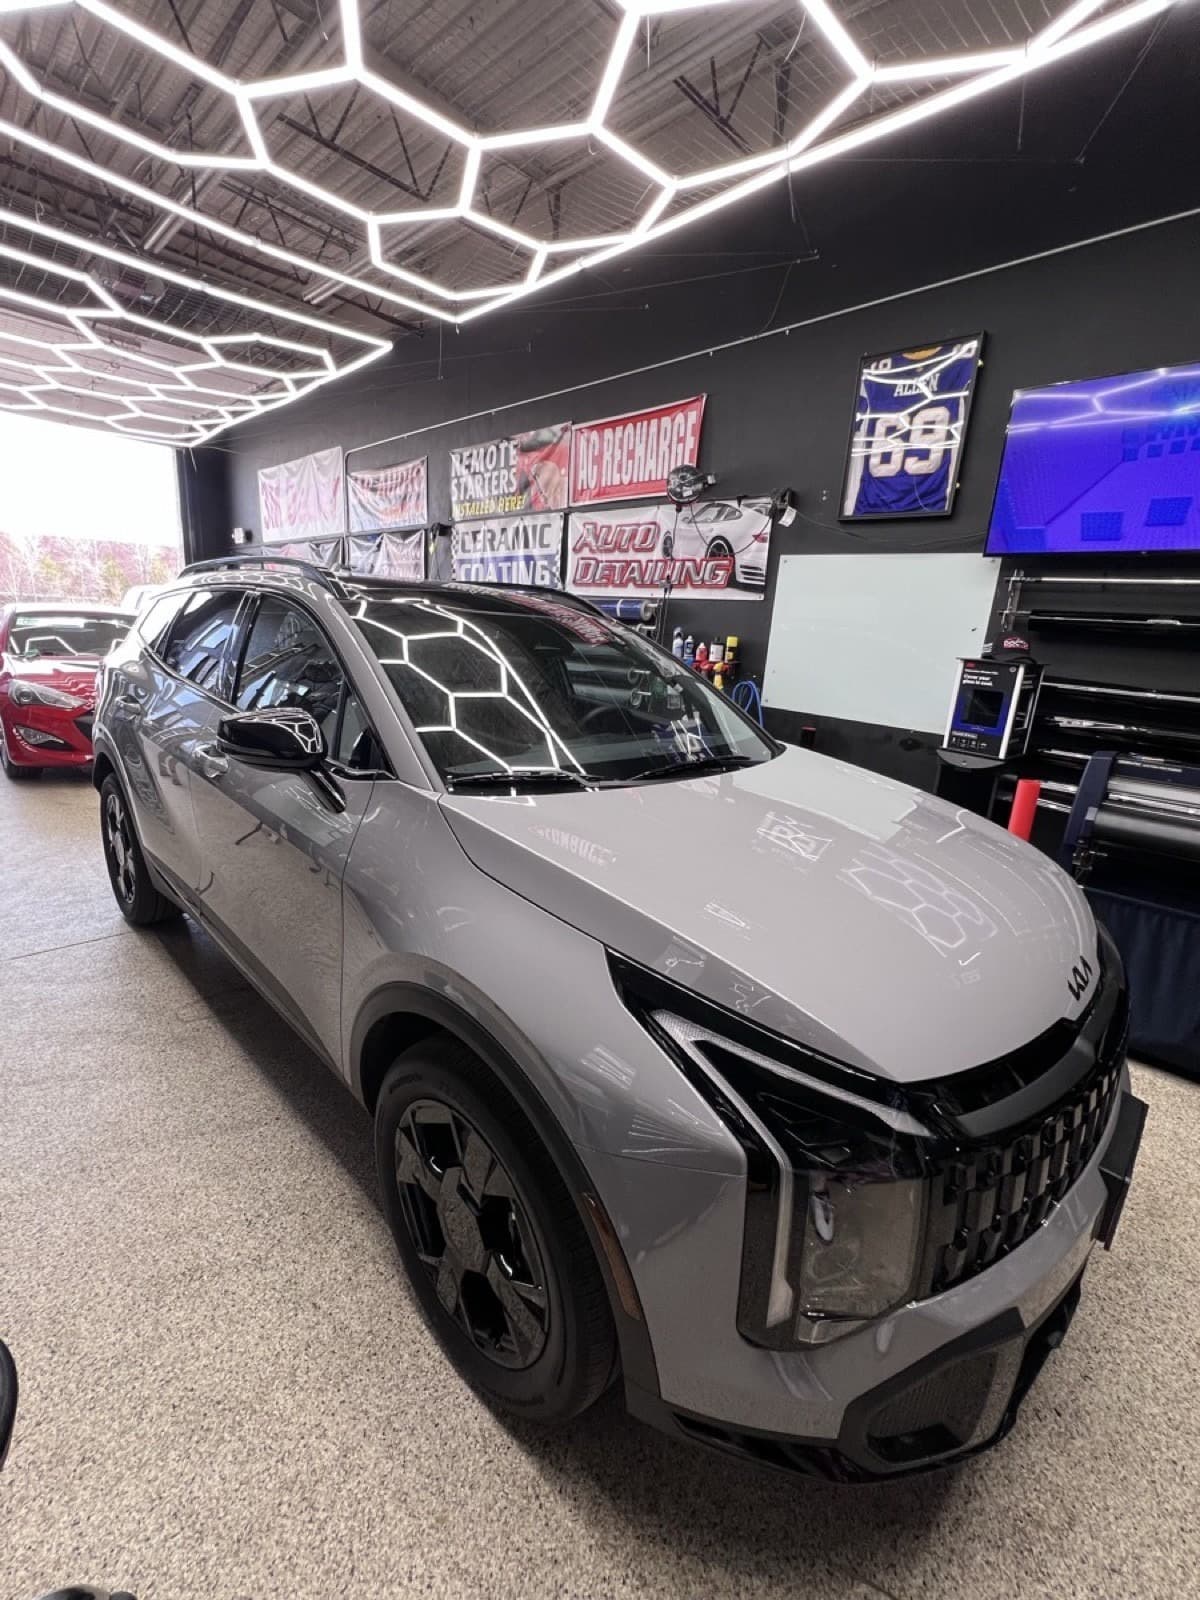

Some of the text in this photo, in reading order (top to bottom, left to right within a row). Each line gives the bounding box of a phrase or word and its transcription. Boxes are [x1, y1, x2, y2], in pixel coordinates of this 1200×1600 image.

[451, 439, 519, 477] REMOTE
[578, 410, 697, 490] AC RECHARGE
[868, 406, 950, 477] 69
[451, 468, 517, 502] STARTERS
[460, 523, 552, 553] CERAMIC
[573, 522, 661, 553] AUTO
[460, 560, 551, 586] COATING
[573, 557, 733, 588] DETAILING
[1066, 955, 1093, 1001] KIA
